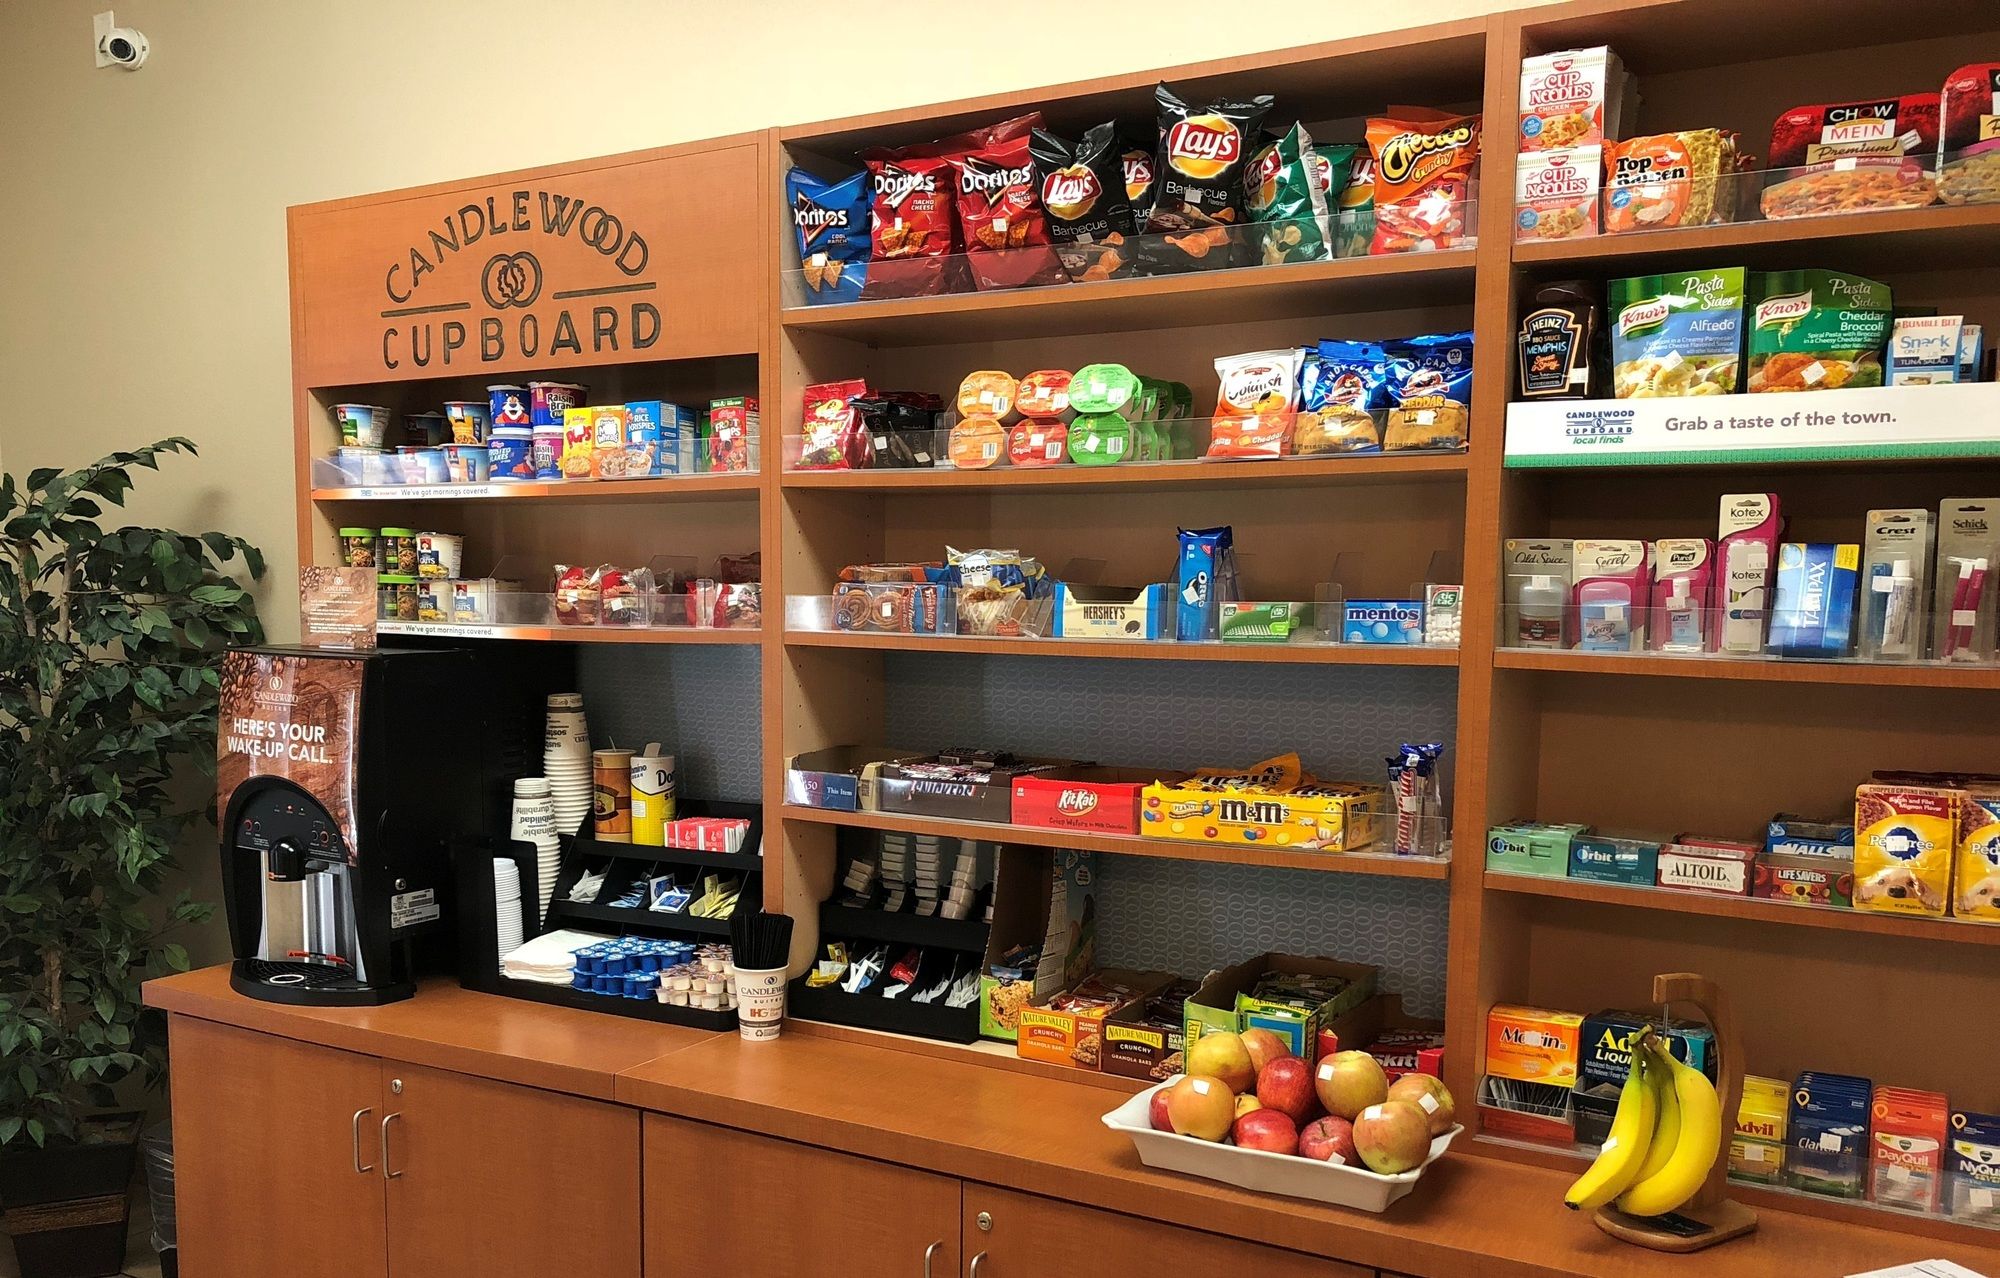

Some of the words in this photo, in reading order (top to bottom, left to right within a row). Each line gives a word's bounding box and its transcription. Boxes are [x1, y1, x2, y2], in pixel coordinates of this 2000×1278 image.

[1545, 71, 1581, 89] CUP
[1529, 82, 1592, 106] NOODLES
[1537, 104, 1570, 112] CHICKEN
[1829, 104, 1894, 122] CHOW
[1830, 124, 1886, 140] MEIN
[1172, 125, 1236, 160] Lay's
[1816, 136, 1898, 159] Premium
[1411, 151, 1454, 182] Crunchy
[1616, 156, 1652, 174] Top
[961, 163, 1031, 193] Doritos
[1540, 167, 1576, 183] CUP
[875, 175, 935, 194] Doritos
[1047, 175, 1093, 205] Lay's
[1525, 178, 1588, 199] NOODLES
[1051, 218, 1108, 237] Barbecue
[386, 190, 649, 304] CANDLEWOOD
[1681, 274, 1724, 299] Pasta
[1828, 279, 1871, 296] Pasta
[1700, 293, 1738, 310] Sides
[1760, 299, 1809, 320] Knorr
[1623, 305, 1668, 327] Knorr
[1839, 311, 1885, 321] Cheddar
[1532, 318, 1562, 331] HEINZ
[1689, 319, 1735, 332] Alfredo
[1840, 322, 1884, 331] Broccoli
[383, 302, 662, 369] CUPBOARD
[1527, 341, 1568, 355] MEMPHIS
[1324, 364, 1347, 387] ANDY
[547, 393, 575, 405] Raisin
[634, 414, 649, 422] RICE
[1566, 410, 1635, 419] CANDLEWOOD
[1665, 416, 1708, 431] Grab
[1713, 420, 1723, 428] a
[1729, 416, 1774, 428] taste
[1780, 411, 1801, 427] of
[1805, 411, 1836, 426] the
[1842, 411, 1897, 424] town.
[628, 422, 656, 431] KRISPIES
[1252, 431, 1284, 444] Cheddar
[1573, 436, 1597, 444] local
[1599, 436, 1625, 444] finds
[401, 488, 420, 496] We've
[421, 488, 432, 497] got
[433, 487, 462, 497] mornings
[463, 486, 490, 495] covered.
[1876, 527, 1916, 535] Crest
[1953, 519, 1988, 530] Schick
[1515, 552, 1537, 564] Old
[1538, 553, 1568, 564] Spice
[1595, 553, 1631, 568] Secret
[959, 564, 991, 574] Cheese
[1197, 571, 1208, 608] OREO
[1439, 592, 1456, 600] tic
[1084, 606, 1126, 620] HERSHEY'S
[1347, 607, 1420, 621] mentos
[405, 625, 424, 633] We've
[425, 626, 436, 635] got
[437, 627, 465, 636] mornings
[466, 628, 494, 636] covered.
[233, 717, 276, 738] HERE'S
[280, 722, 325, 743] YOUR
[228, 736, 284, 758] WAKE-UP
[288, 743, 333, 764] CALL.
[827, 786, 839, 796] This
[840, 788, 853, 797] Item
[1174, 804, 1197, 812] PEANUT
[1490, 837, 1526, 855] Orbit
[1576, 848, 1613, 864] Orbit
[1777, 870, 1797, 881] LIFE
[1797, 871, 1827, 883] SAVERS
[750, 1008, 769, 1017] IHG
[1022, 1012, 1048, 1024] NATURE
[1048, 1016, 1072, 1031] VALLEY
[1033, 1029, 1063, 1039] CRUNCHY
[1108, 1026, 1135, 1039] NATURE
[1135, 1030, 1160, 1047] VALLEY
[1120, 1043, 1152, 1054] CRUNCHY
[1111, 1053, 1137, 1062] GRANOLA
[1138, 1058, 1152, 1066] BARS
[1877, 1148, 1929, 1167] DayQuil
